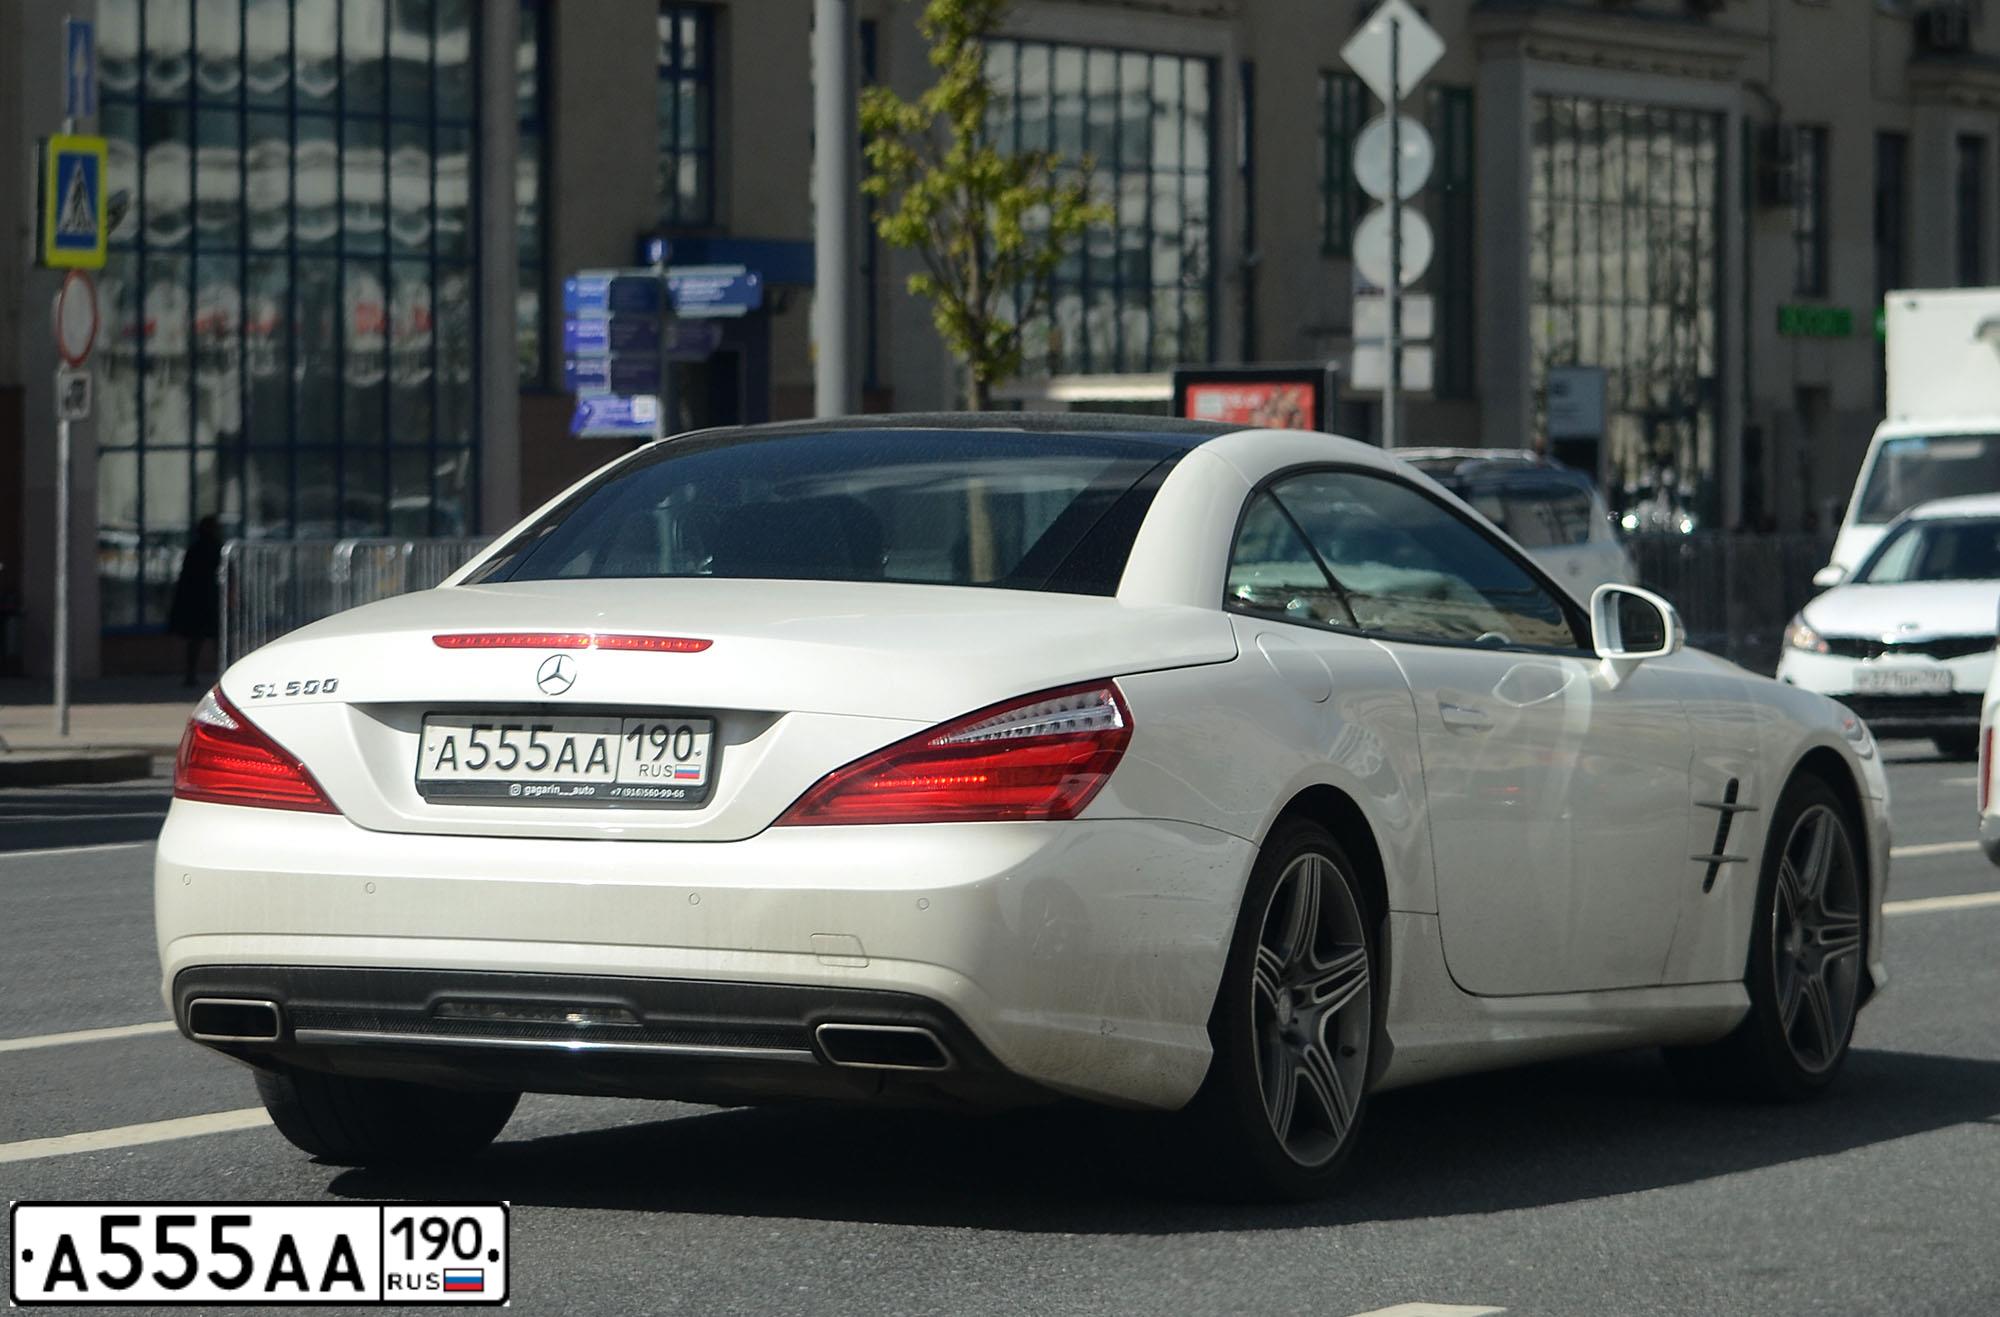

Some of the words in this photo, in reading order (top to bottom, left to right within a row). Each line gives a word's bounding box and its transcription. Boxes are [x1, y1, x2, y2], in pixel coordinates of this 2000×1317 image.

[285, 678, 339, 696] 500
[435, 724, 609, 773] A555AA
[626, 724, 694, 761] 190
[639, 764, 673, 778] RUS
